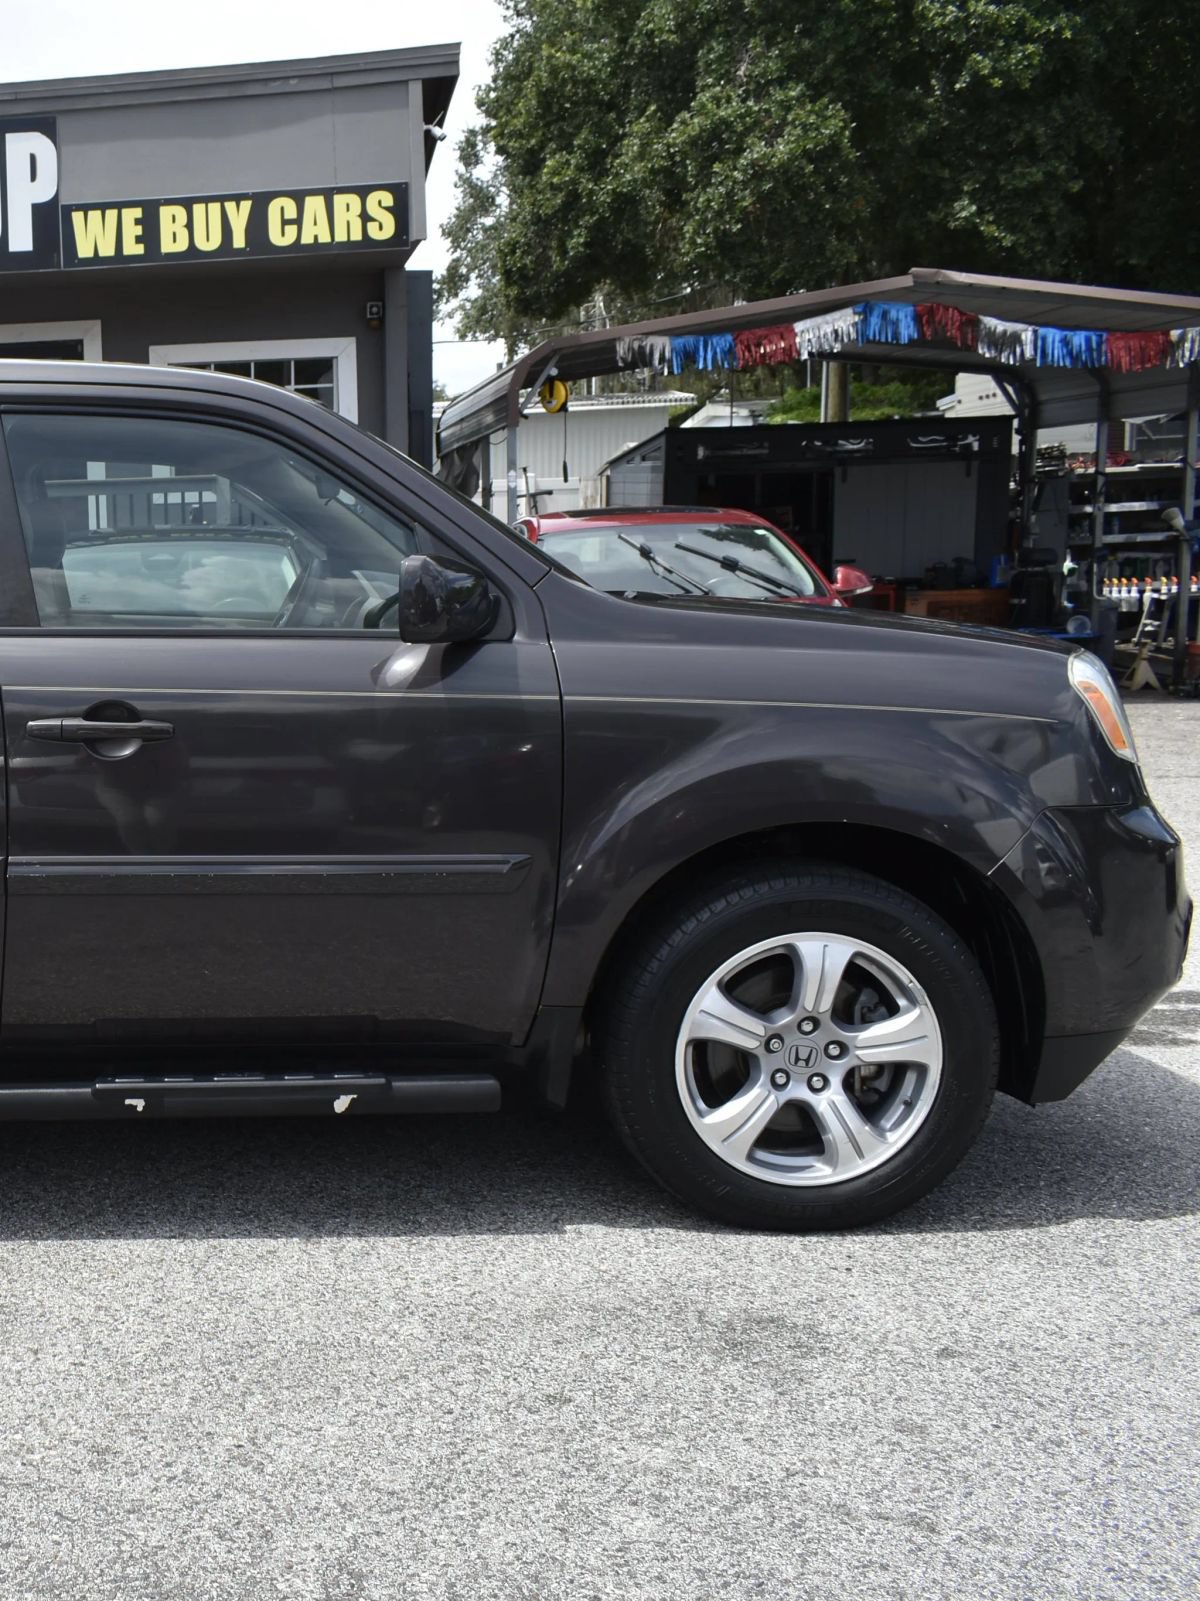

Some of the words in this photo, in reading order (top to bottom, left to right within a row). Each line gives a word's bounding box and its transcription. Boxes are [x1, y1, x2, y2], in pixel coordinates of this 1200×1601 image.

[71, 207, 145, 258] WE
[159, 200, 252, 254] BUY
[267, 190, 396, 247] CARS
